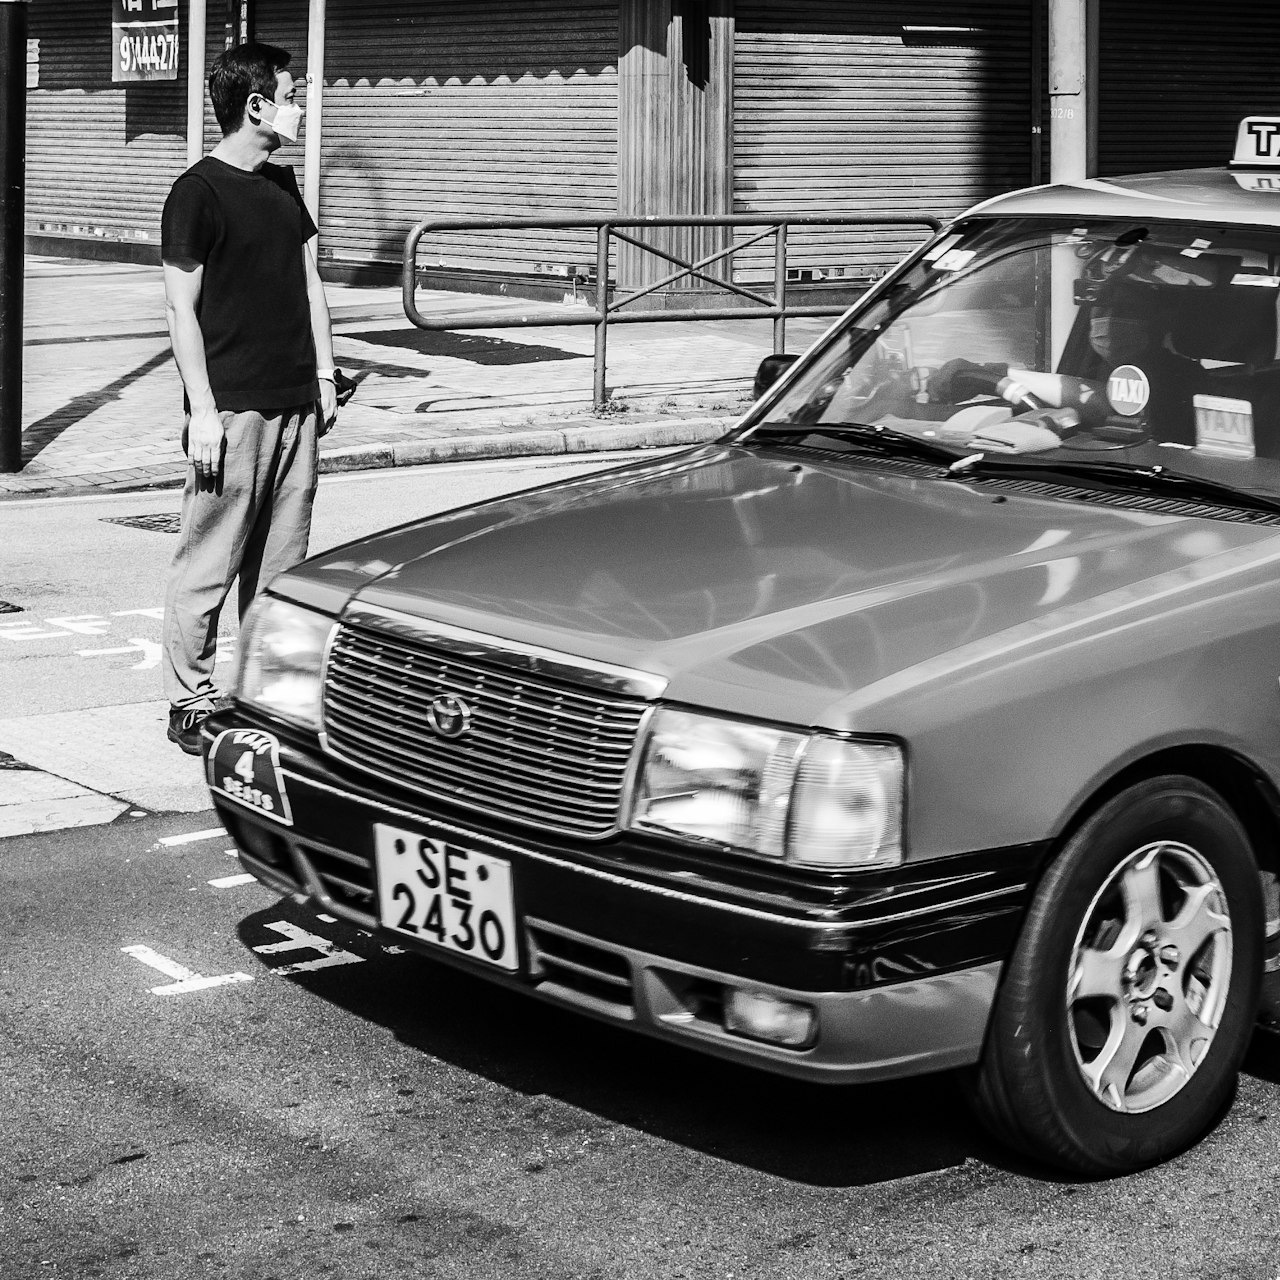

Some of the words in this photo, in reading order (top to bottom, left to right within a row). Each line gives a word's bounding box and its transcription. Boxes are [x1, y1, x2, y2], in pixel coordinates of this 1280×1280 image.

[1109, 376, 1146, 404] TAXI
[233, 731, 273, 755] TAXI
[234, 751, 255, 784] 4
[223, 776, 274, 811] SEATS
[416, 838, 472, 901] SE
[392, 882, 505, 961] 2430
